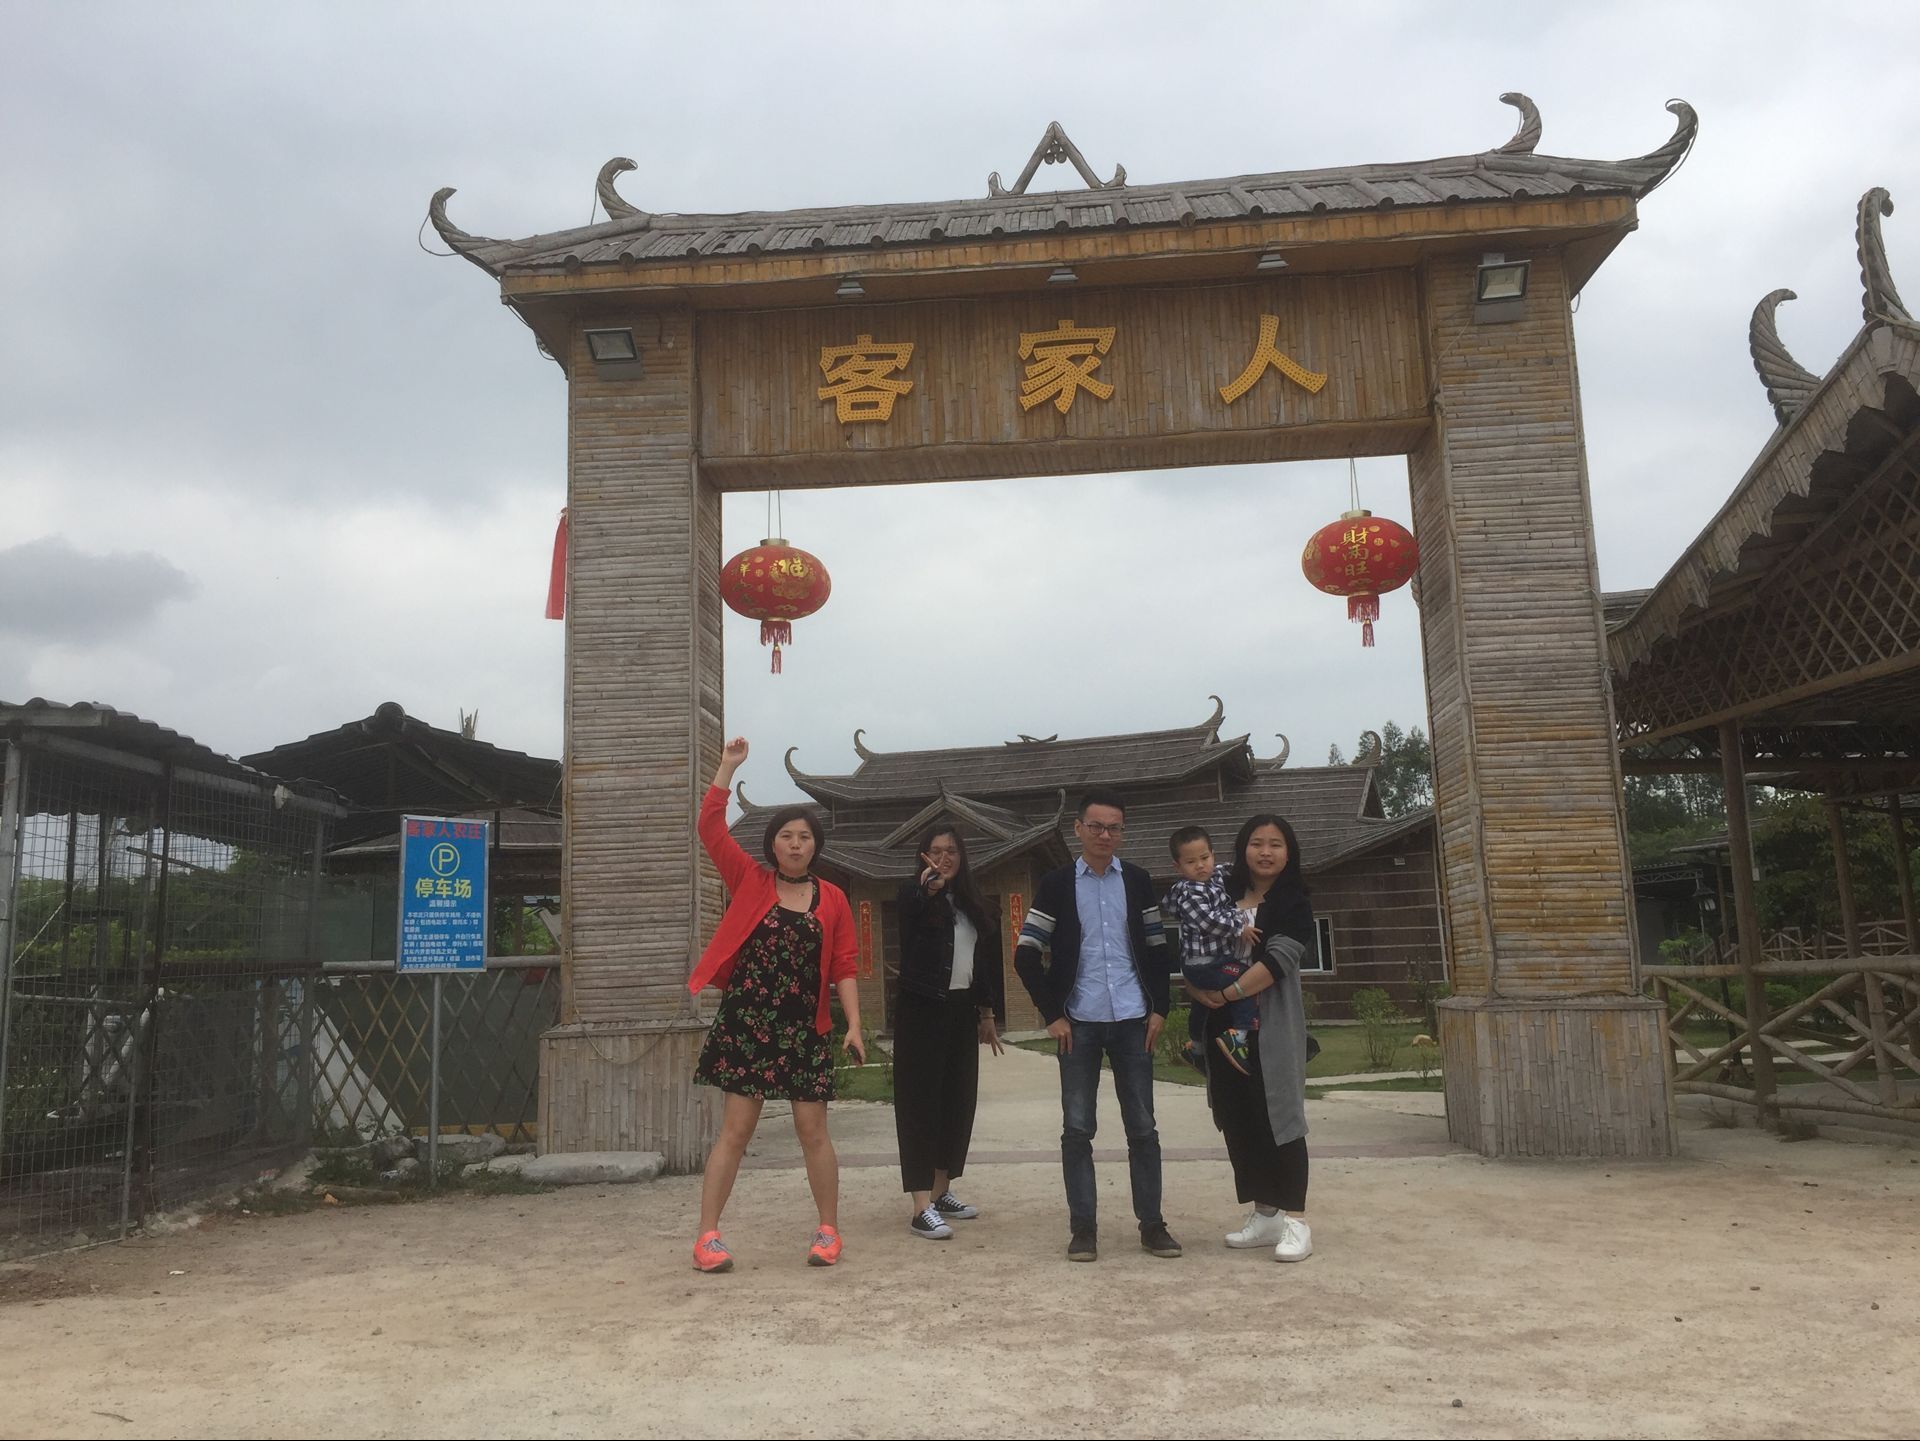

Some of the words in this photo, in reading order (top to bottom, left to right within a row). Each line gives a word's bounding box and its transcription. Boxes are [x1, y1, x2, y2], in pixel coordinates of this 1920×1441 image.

[818, 313, 1328, 425] 客家人
[415, 877, 472, 899] 停车场
